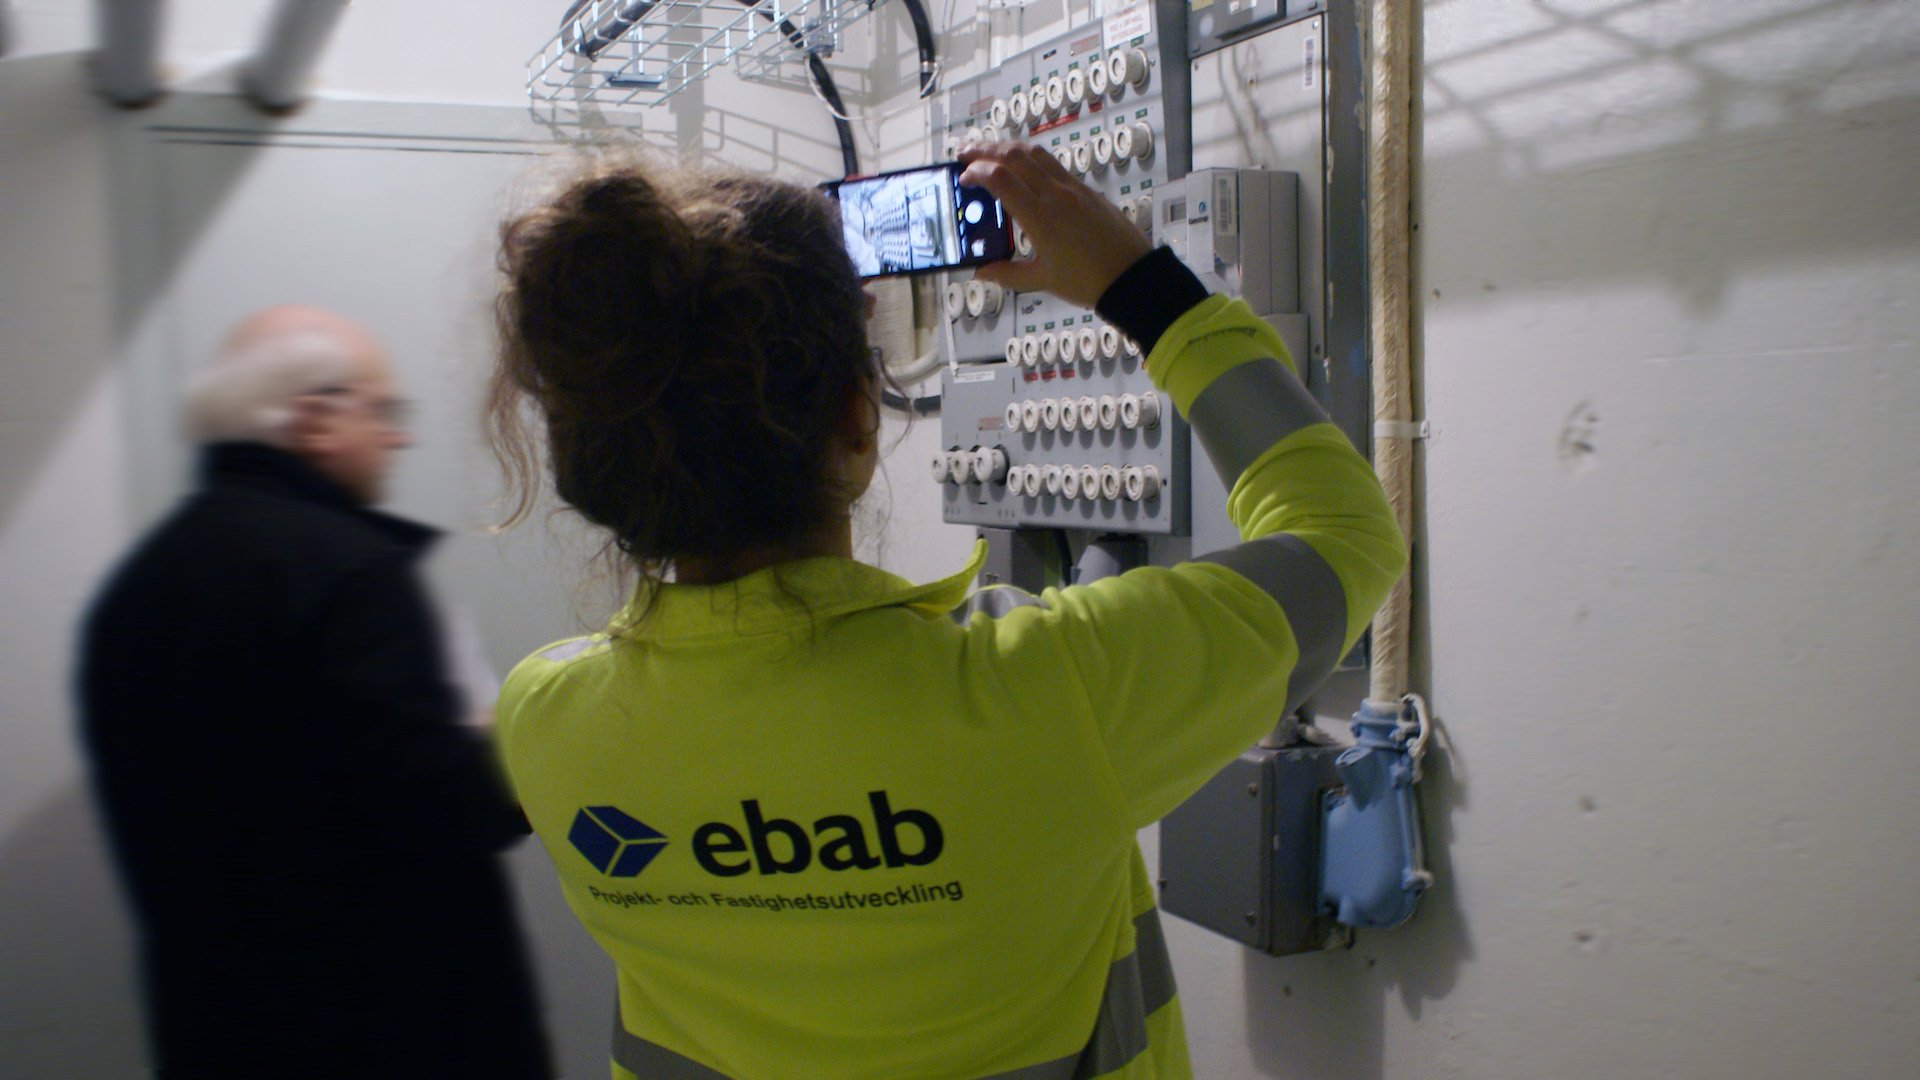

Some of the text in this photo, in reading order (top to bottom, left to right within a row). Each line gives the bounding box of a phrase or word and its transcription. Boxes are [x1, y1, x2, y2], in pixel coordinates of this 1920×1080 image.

[692, 790, 944, 878] ebab
[588, 880, 964, 911] Projekt- och Fastighetsutveckling
